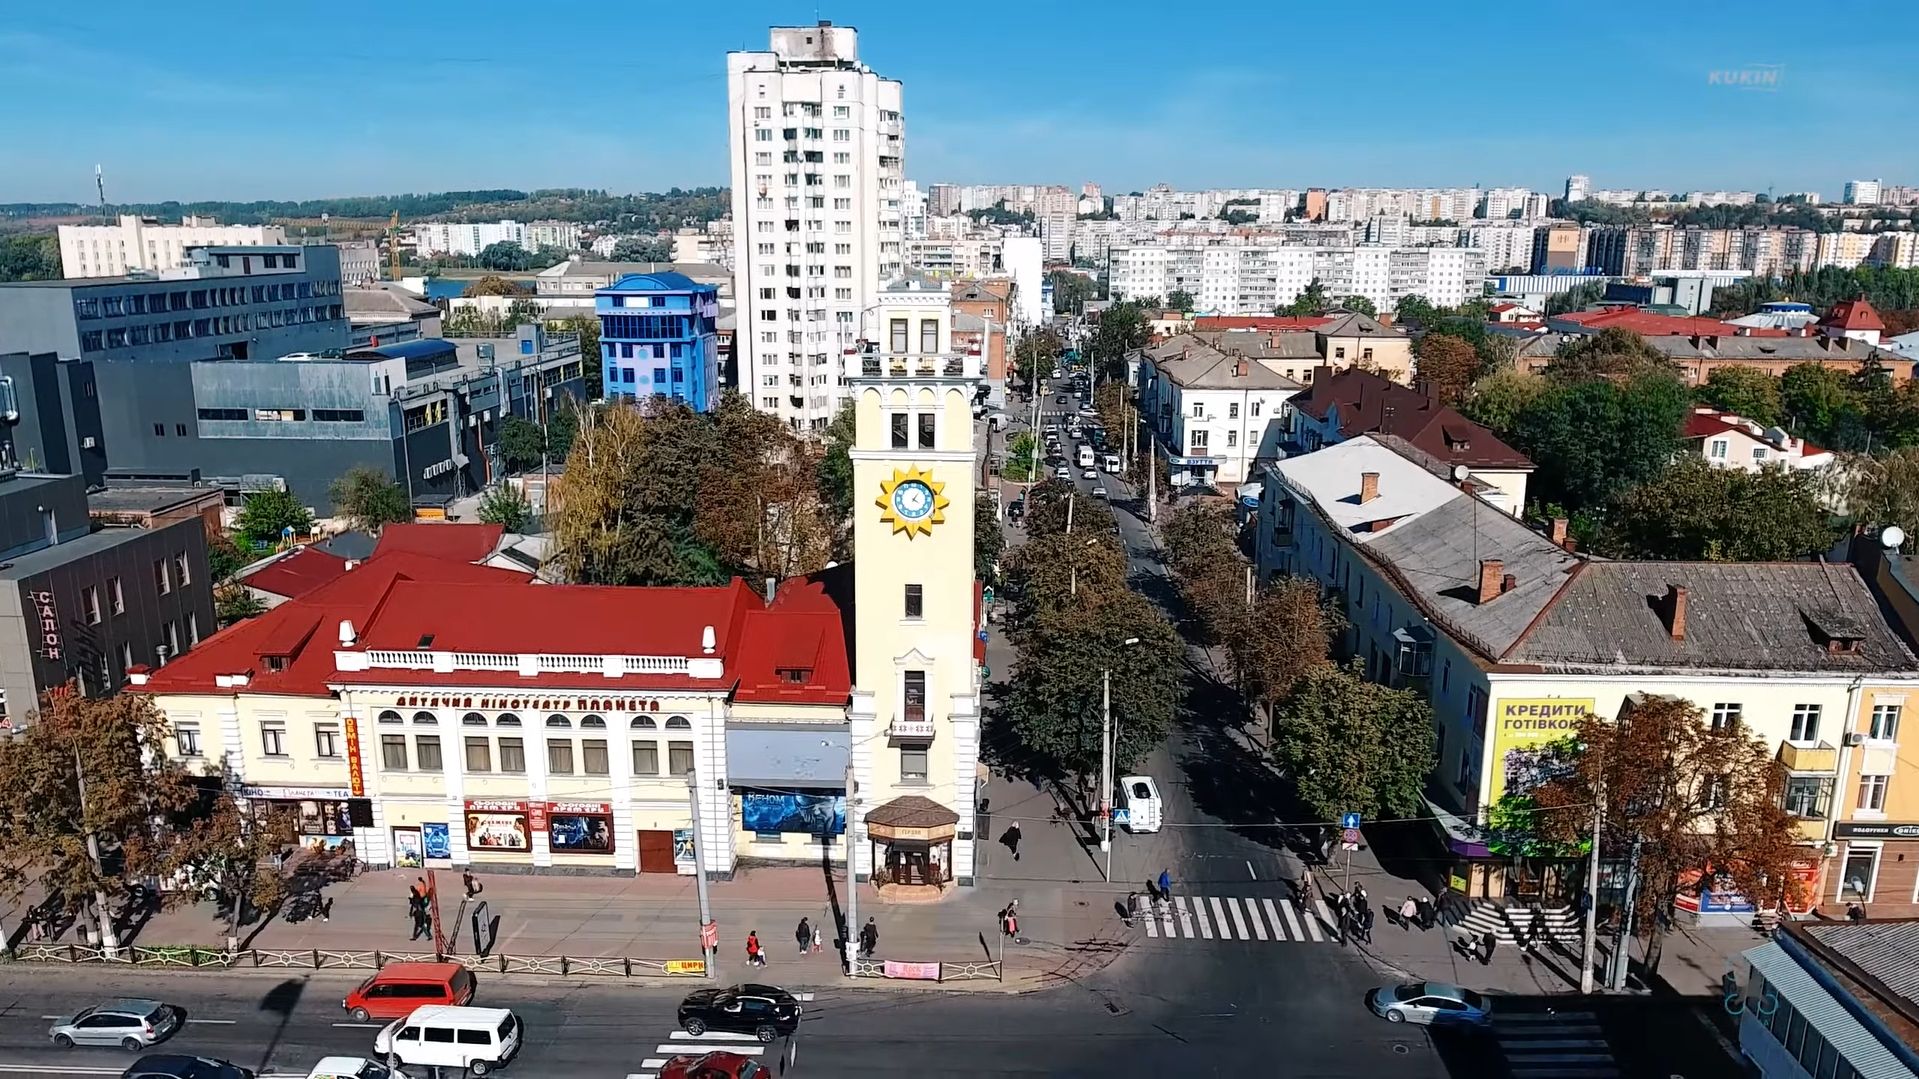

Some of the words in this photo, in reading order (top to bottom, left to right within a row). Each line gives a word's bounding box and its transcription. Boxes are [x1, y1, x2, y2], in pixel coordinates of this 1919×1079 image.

[39, 591, 59, 660] САЛОН
[396, 696, 472, 708] ДИТЯЧИЙ
[481, 698, 571, 710] КІНОТЕАТР
[577, 699, 660, 711] ПЛАНЕТА
[1505, 704, 1585, 718] КРЕДИТИ
[346, 718, 357, 753] ОБМІН
[681, 961, 704, 969] ЦИРК
